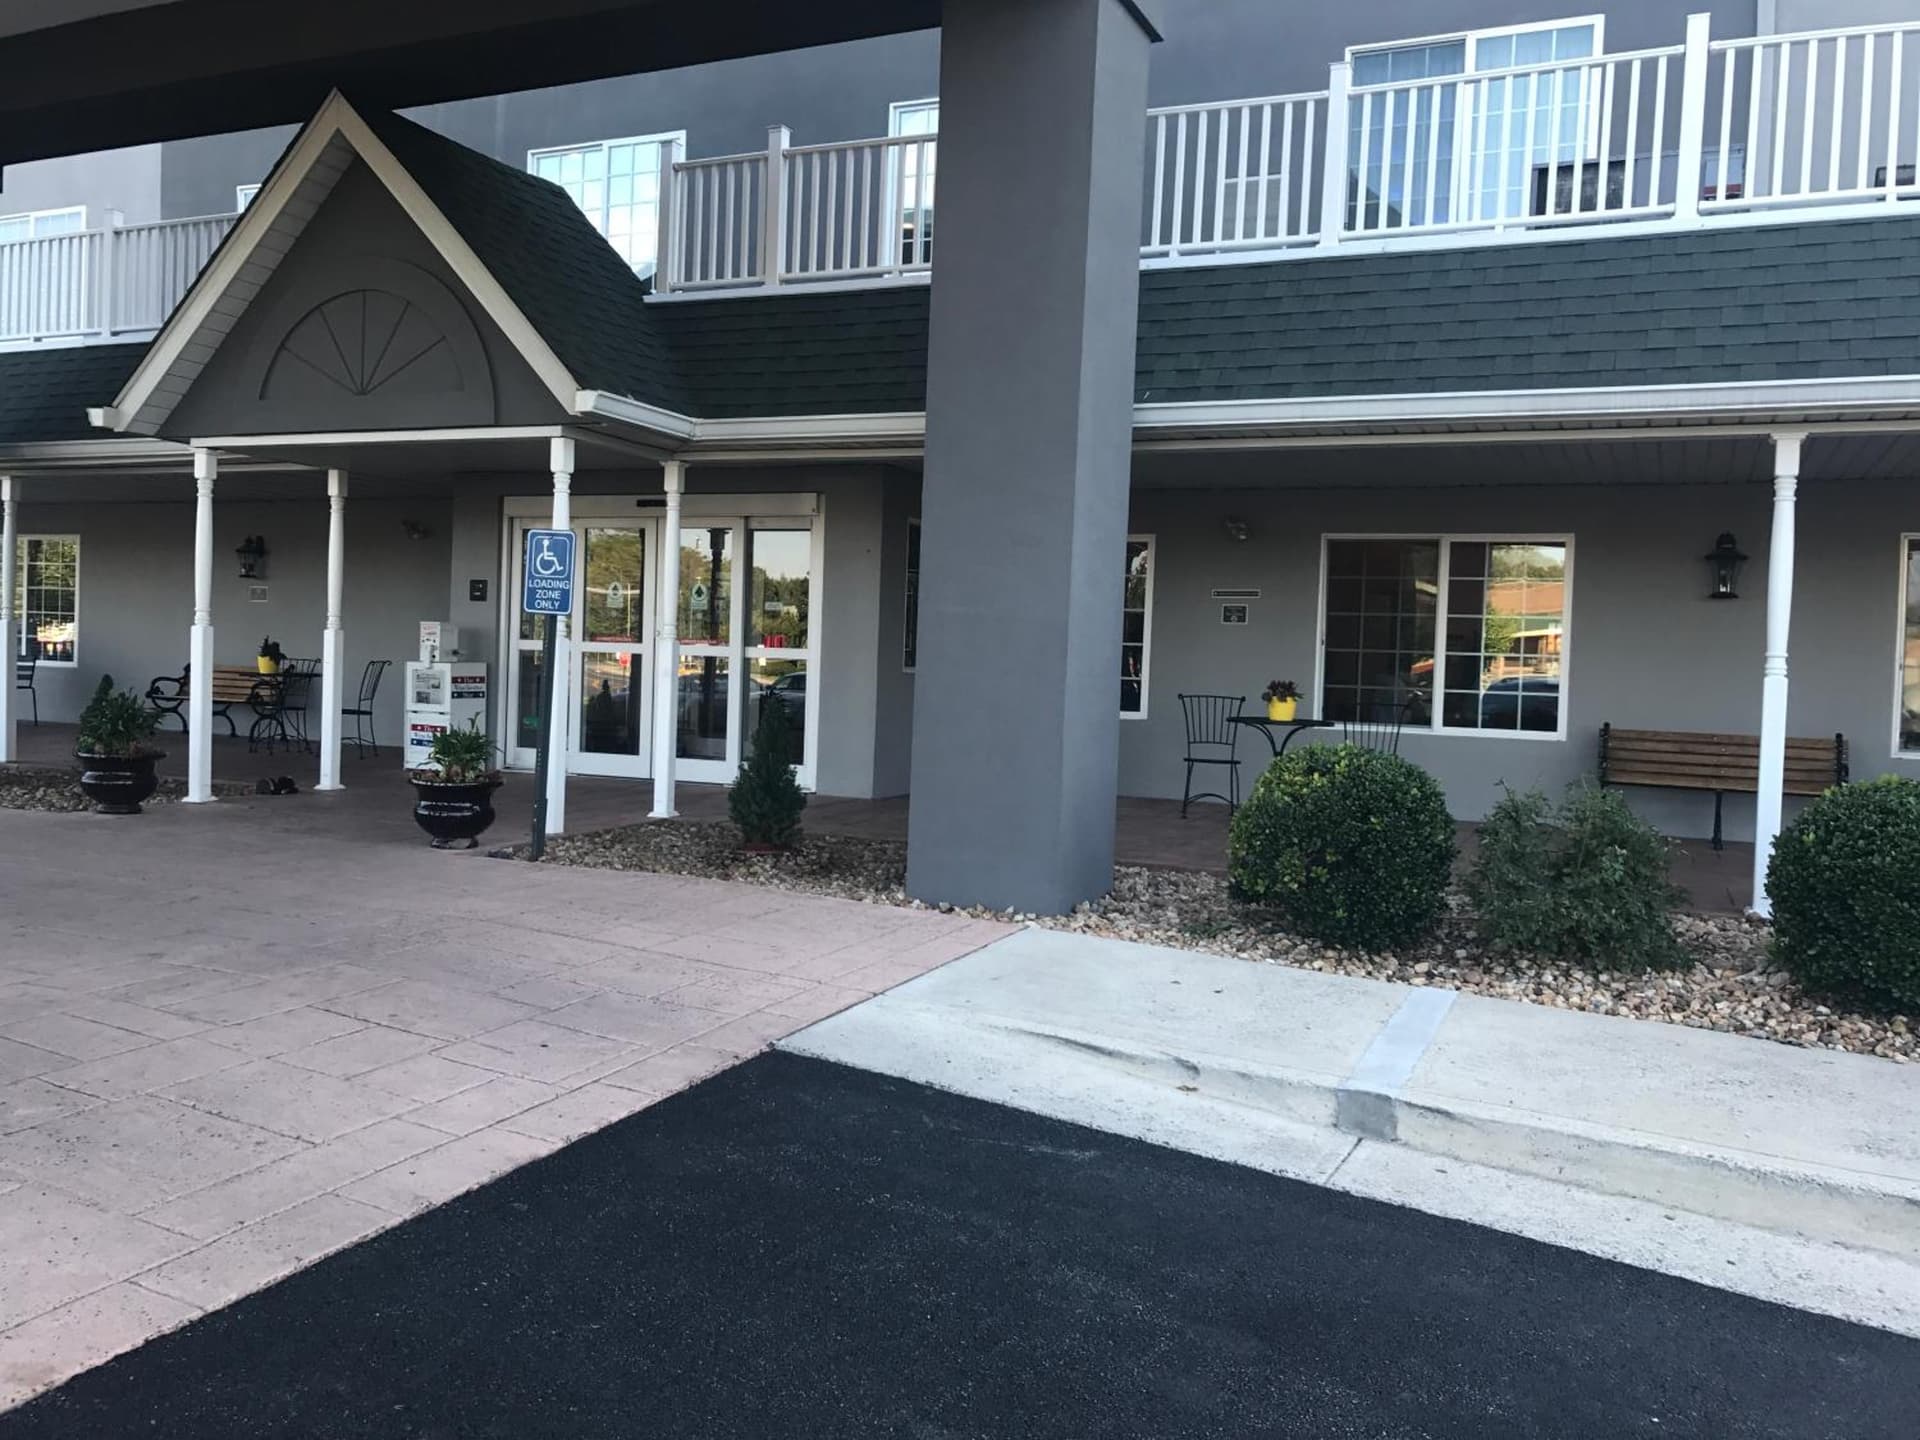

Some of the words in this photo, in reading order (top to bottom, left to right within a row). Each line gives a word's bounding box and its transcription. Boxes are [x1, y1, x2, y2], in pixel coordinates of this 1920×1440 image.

[528, 579, 569, 589] LOADING
[535, 589, 561, 599] ZONE
[534, 600, 560, 609] ONLY
